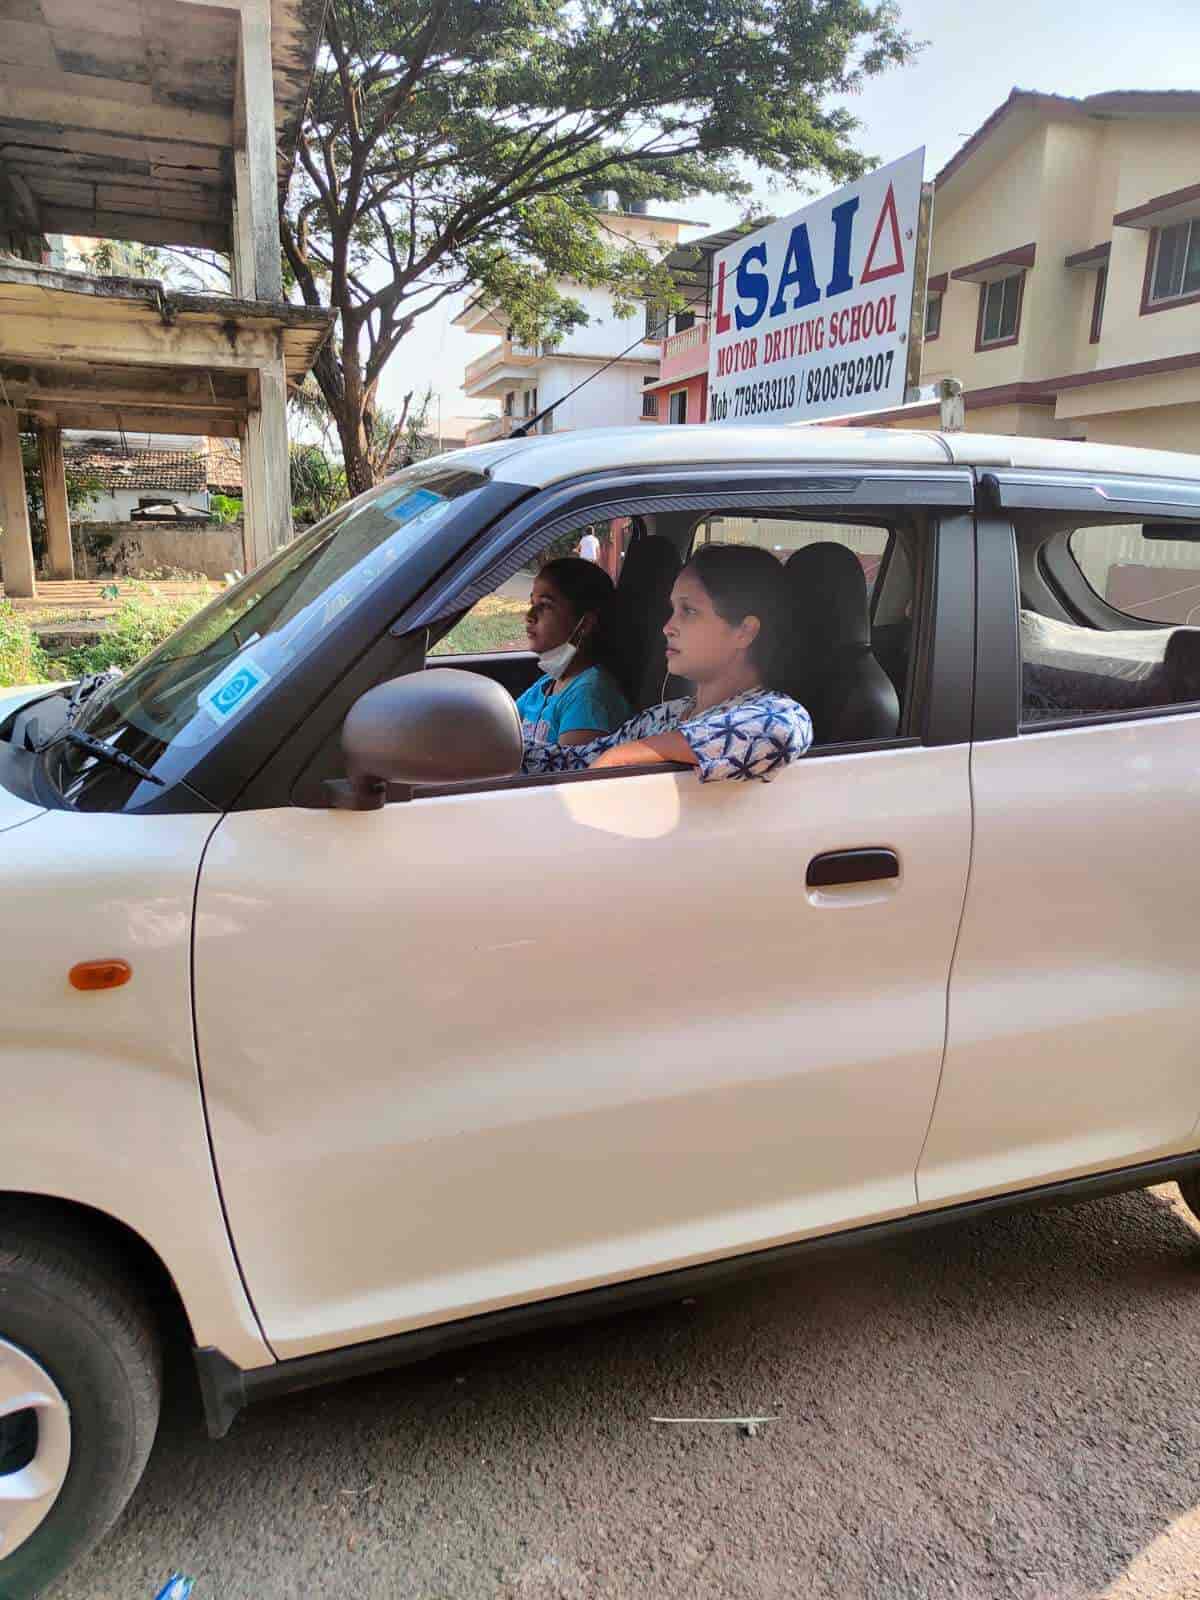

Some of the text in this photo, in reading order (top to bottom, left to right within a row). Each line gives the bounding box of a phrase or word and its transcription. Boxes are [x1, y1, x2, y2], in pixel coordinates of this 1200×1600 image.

[734, 196, 860, 331] SAI
[716, 294, 897, 377] MOTOR DRIVING SCHOOL
[806, 350, 894, 404] 8208792207
